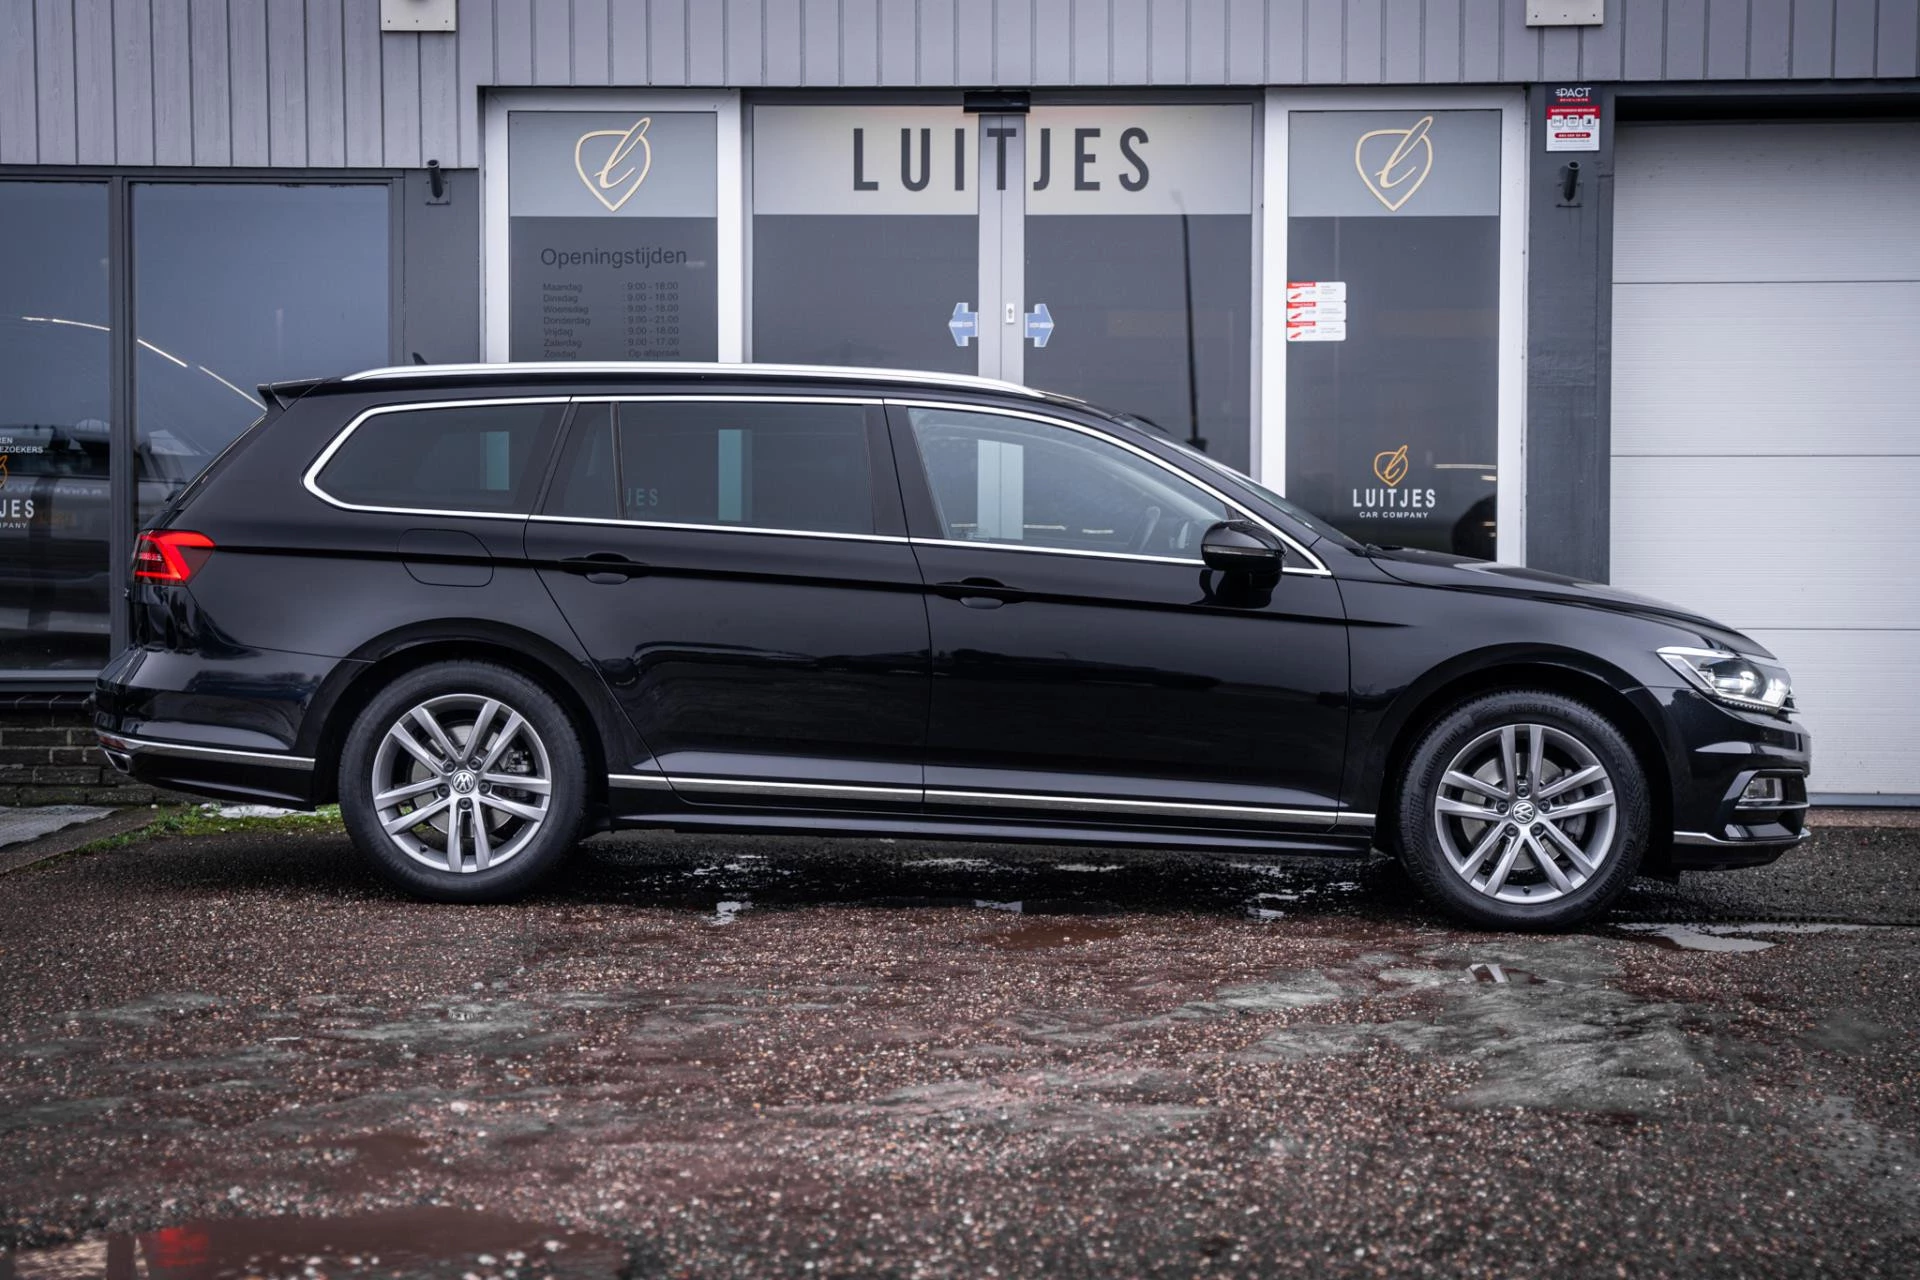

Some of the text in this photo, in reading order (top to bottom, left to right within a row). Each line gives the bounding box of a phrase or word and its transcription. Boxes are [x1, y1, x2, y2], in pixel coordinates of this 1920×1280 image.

[853, 127, 1150, 192] LUITJES
[541, 248, 687, 269] Openingstijden
[1353, 488, 1436, 508] LUITJES
[0, 499, 34, 518] JES
